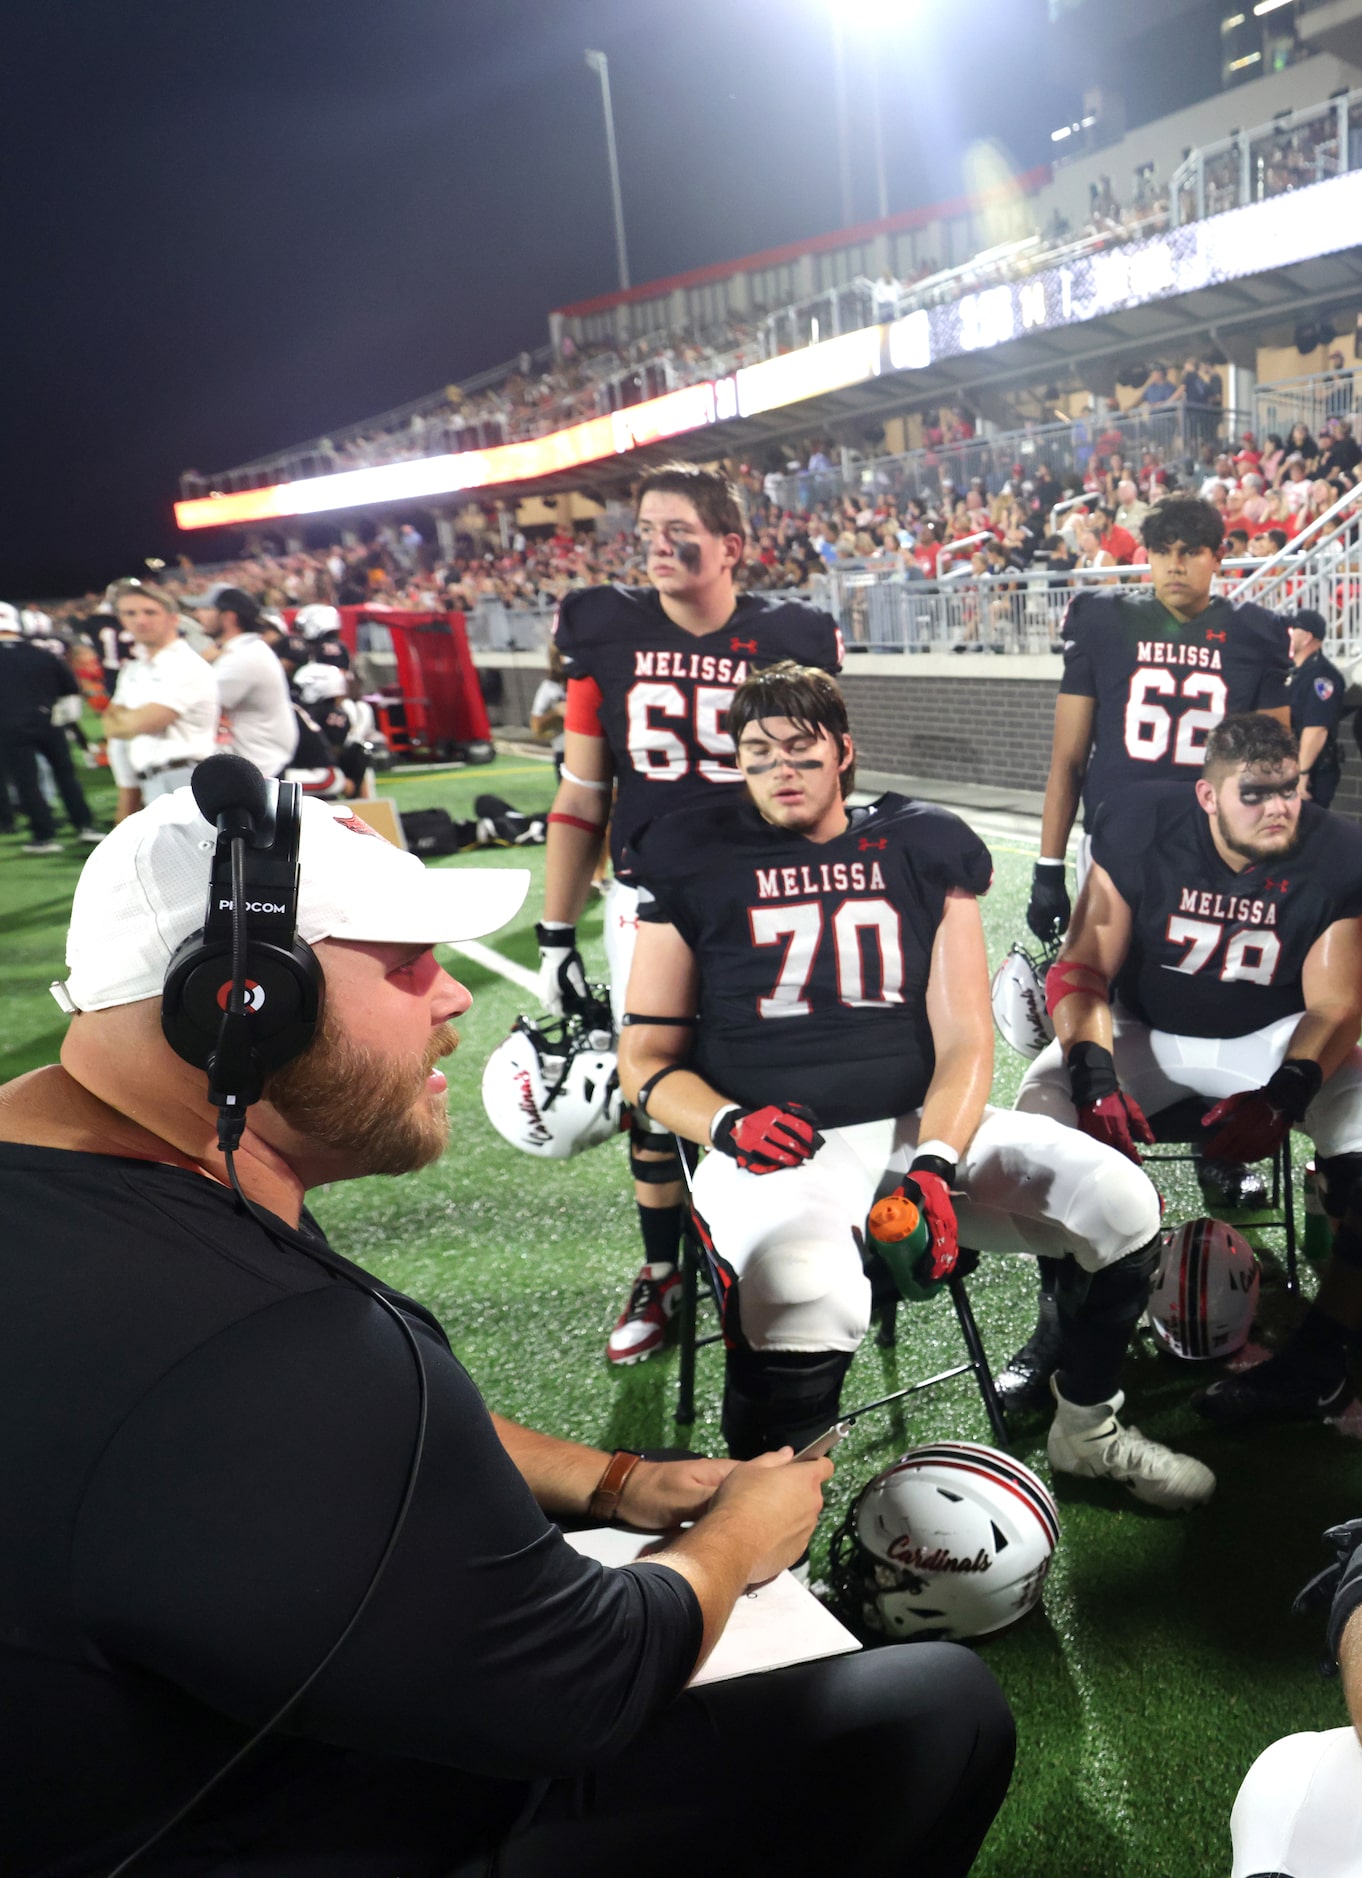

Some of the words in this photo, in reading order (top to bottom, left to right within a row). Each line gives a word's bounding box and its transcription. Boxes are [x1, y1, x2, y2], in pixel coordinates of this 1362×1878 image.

[635, 651, 749, 684] MELISSA
[1136, 641, 1223, 670] MELISSA
[626, 680, 745, 783] 65
[1123, 666, 1228, 767] 62
[755, 861, 887, 898] MELISSA
[219, 899, 287, 914] PCOM
[1179, 887, 1277, 925] MELISSA
[747, 896, 906, 1019] 70
[1160, 913, 1283, 987] 78
[886, 1534, 993, 1575] Cardinals
